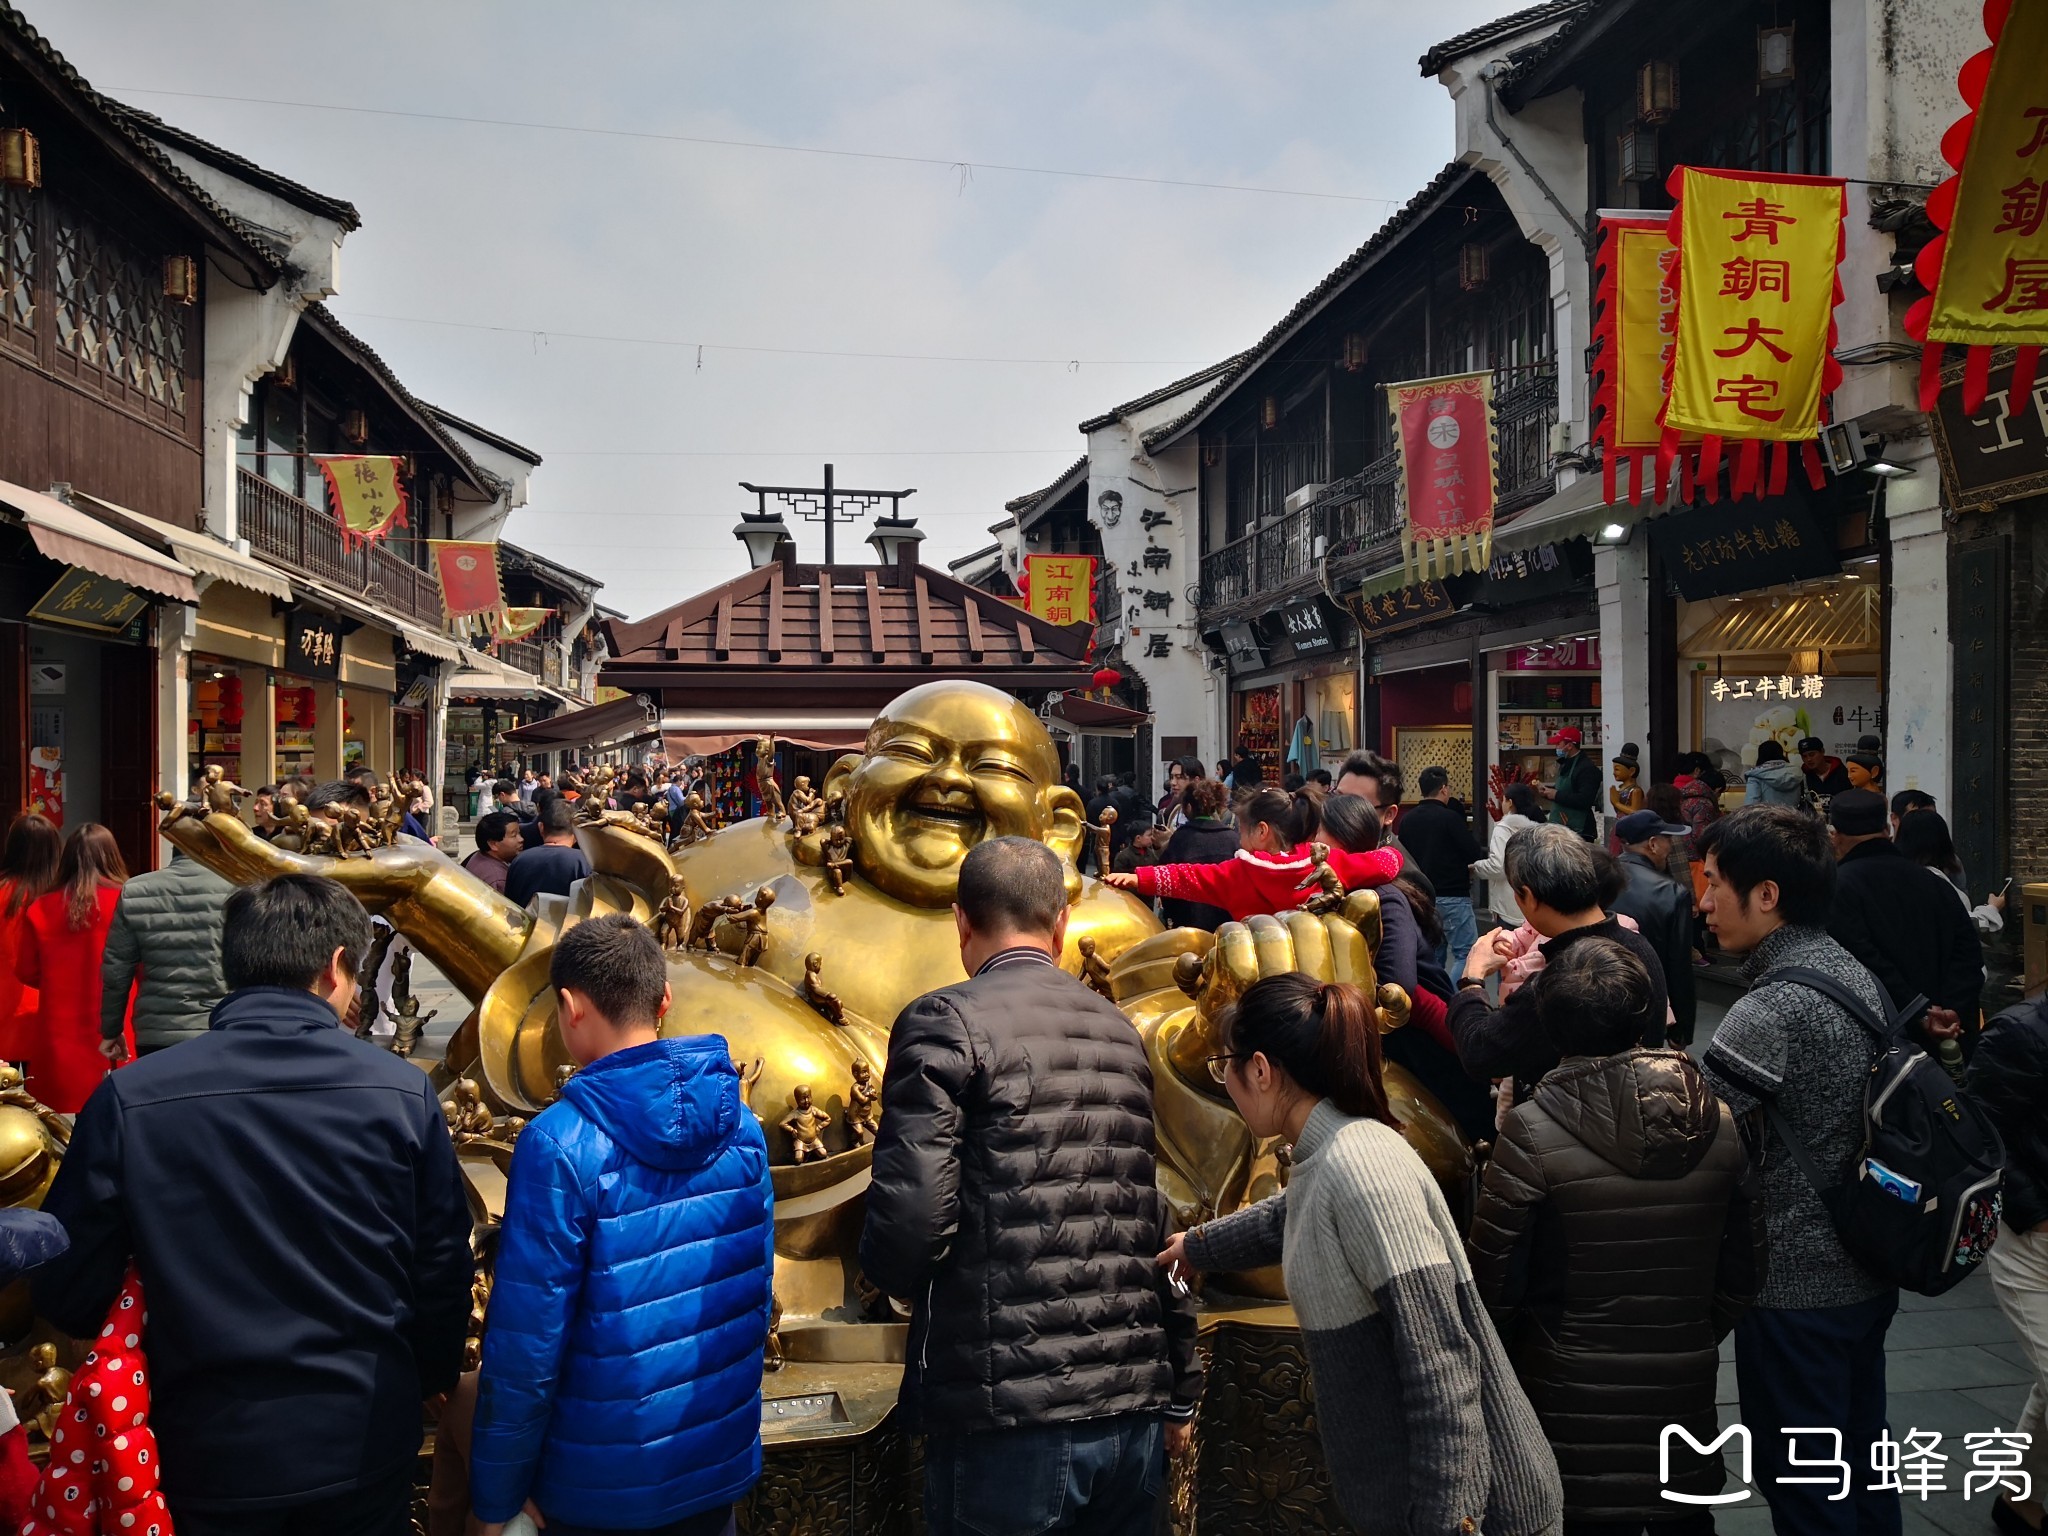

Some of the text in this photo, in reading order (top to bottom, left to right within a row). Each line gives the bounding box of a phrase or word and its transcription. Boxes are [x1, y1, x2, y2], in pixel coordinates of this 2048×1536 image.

[1713, 197, 1797, 422] 青銅大宅
[1045, 564, 1074, 622] 江南銅
[301, 626, 335, 667] 万事隆
[1295, 636, 1329, 651] Women Stories
[1710, 674, 1825, 702] 手工牛軋糖
